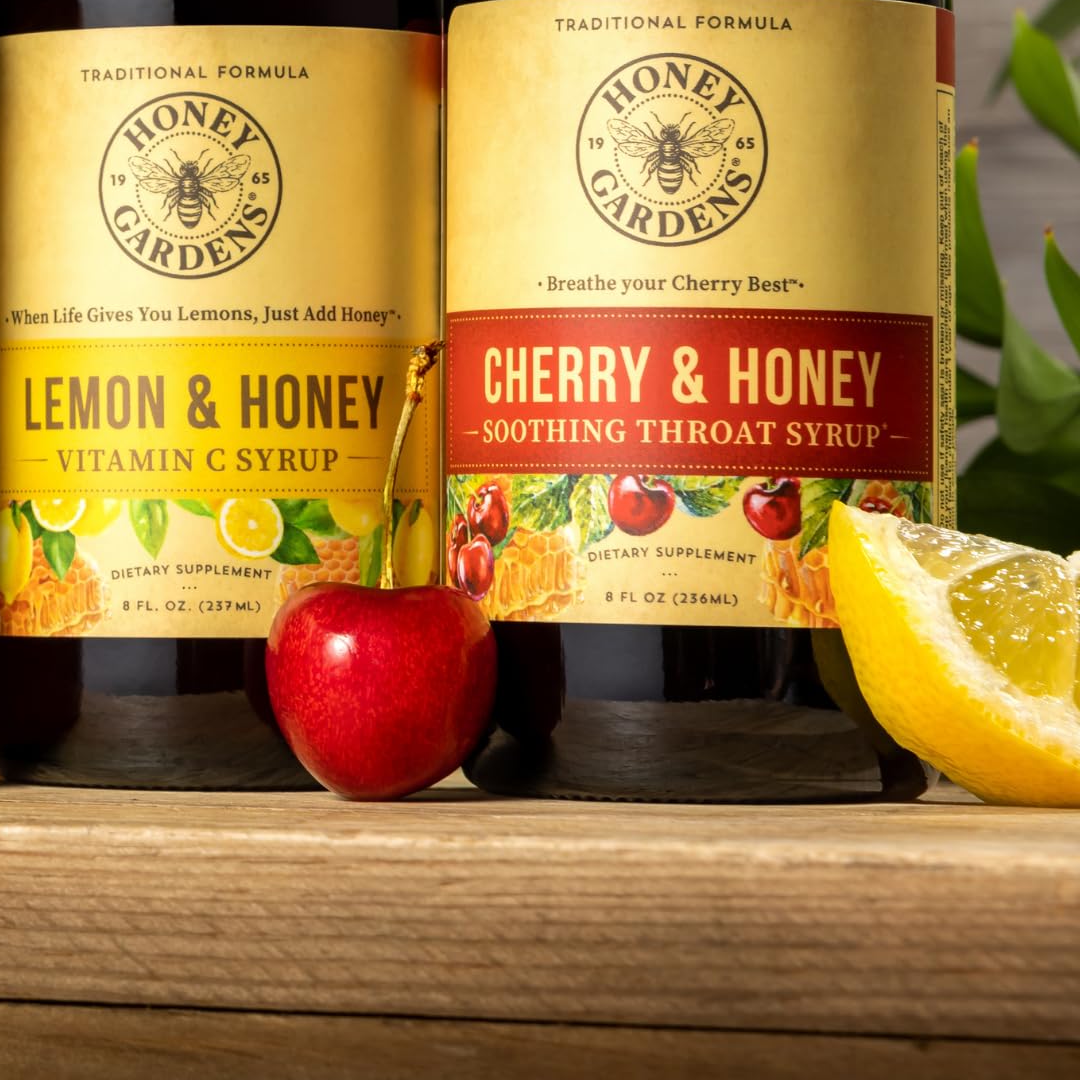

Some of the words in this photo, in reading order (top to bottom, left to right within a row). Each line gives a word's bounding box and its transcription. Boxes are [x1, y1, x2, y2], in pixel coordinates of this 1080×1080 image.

[555, 17, 687, 32] TRADITIONAL
[696, 16, 793, 31] FORMULA
[81, 66, 207, 82] TRADITIONAL
[218, 66, 310, 79] FORMULA
[601, 62, 745, 114] HONEY
[123, 99, 260, 151] HONEY
[588, 137, 604, 150] 19
[736, 137, 755, 149] 65
[111, 173, 125, 186] 19
[252, 172, 270, 185] 65
[547, 274, 617, 292] Breathe
[621, 278, 667, 296] your
[672, 274, 742, 296] Cherry
[11, 309, 48, 325] When
[53, 308, 83, 324] Life
[87, 307, 133, 323] Gives
[139, 306, 172, 322] You
[177, 306, 258, 325] Lemons,
[262, 306, 299, 324] Just
[304, 306, 336, 321] Add
[484, 346, 652, 404] CHERRY
[672, 347, 708, 404] &
[729, 349, 883, 407] HONEY
[26, 375, 164, 431] LEMON
[187, 374, 221, 429] &
[241, 375, 384, 429] HONEY
[482, 419, 626, 443] SOOTHING
[636, 420, 776, 446] THROAT
[57, 448, 195, 472] VITAMIN
[206, 449, 226, 472] C
[236, 448, 339, 472] SYRUP
[588, 547, 649, 563] DIETARY
[656, 547, 757, 565] SUPPLEMENT
[111, 565, 170, 580] DIETARY
[176, 564, 273, 579] SUPPLEMENT
[122, 601, 130, 610] 8
[136, 601, 159, 611] FL.
[165, 601, 192, 611] OZ.
[198, 600, 261, 613] (237ML)
[605, 591, 613, 603] 8
[620, 591, 637, 603] FL
[644, 591, 667, 604] OZ
[674, 591, 739, 607] (236ML)
